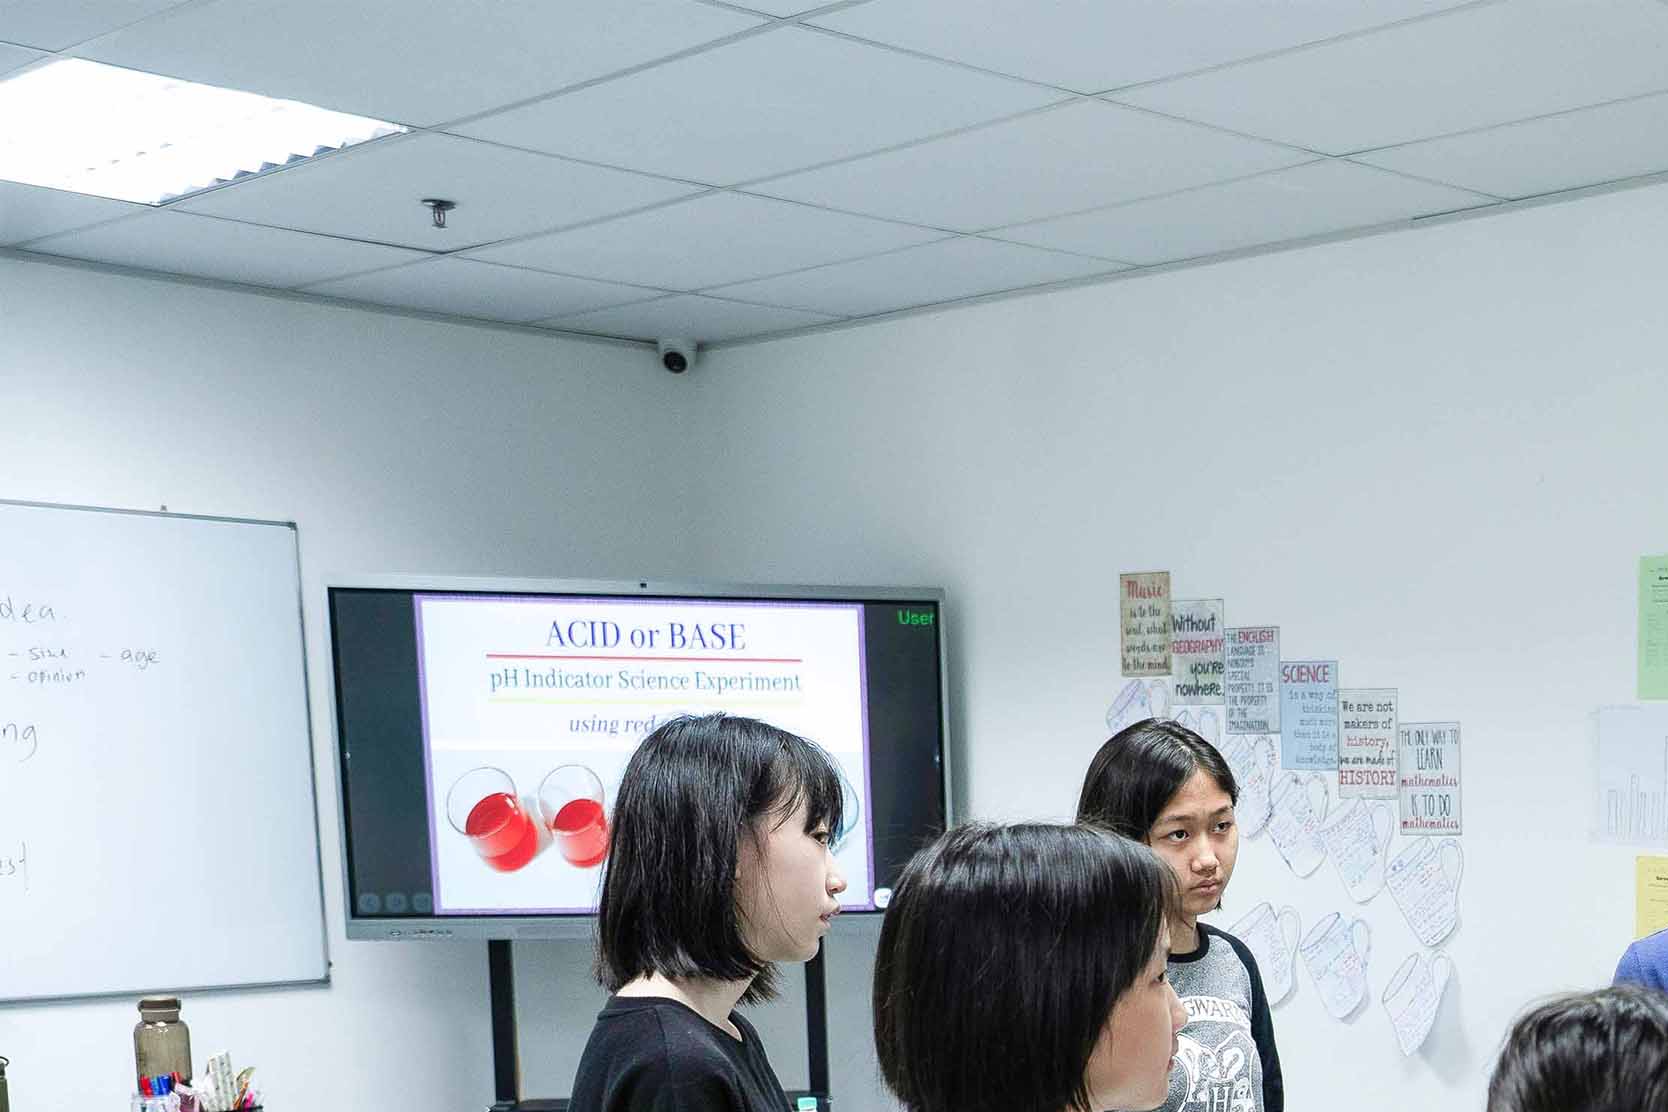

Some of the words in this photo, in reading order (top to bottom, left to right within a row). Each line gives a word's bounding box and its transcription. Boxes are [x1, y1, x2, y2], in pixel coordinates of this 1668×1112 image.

[1127, 581, 1162, 599] Music
[897, 607, 935, 625] User
[1172, 613, 1216, 633] Without
[547, 620, 621, 648] ACID
[631, 627, 660, 649] or
[670, 622, 746, 650] BASE
[1238, 631, 1274, 643] ENGLISH
[1171, 639, 1224, 654] GEOGRAPHY
[490, 668, 519, 692] pH
[525, 668, 613, 689] Indicator
[619, 669, 689, 690] Science
[695, 671, 802, 695] Experiment
[1282, 664, 1329, 683] SCIENCE
[1342, 701, 1354, 712] We
[1357, 703, 1374, 712] are
[1377, 701, 1394, 712] not
[569, 714, 620, 735] using
[624, 714, 656, 733] red
[1344, 719, 1379, 729] makers
[1382, 718, 1393, 729] of
[1417, 748, 1443, 770] LEARN
[1340, 770, 1396, 785] HISTORY
[1401, 774, 1457, 787] mathematics
[1422, 794, 1435, 816] TO
[1439, 794, 1451, 816] DO
[1402, 817, 1458, 829] mathematics
